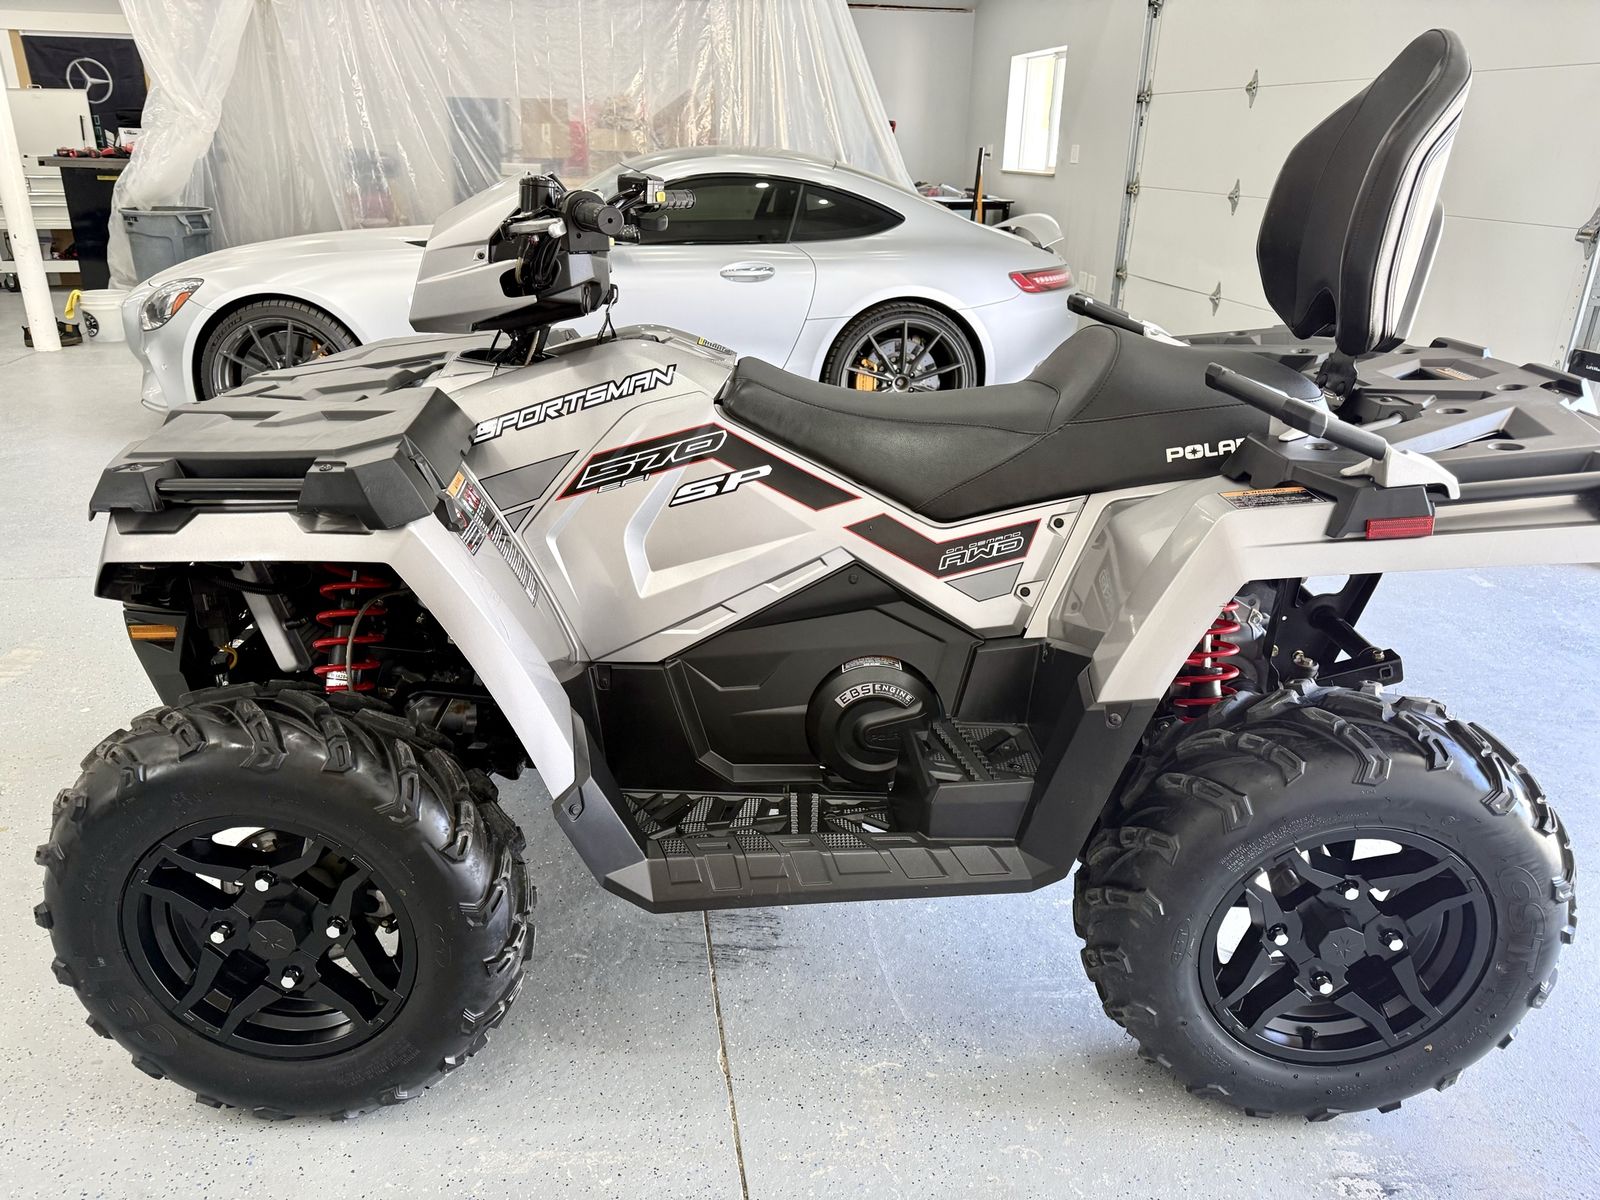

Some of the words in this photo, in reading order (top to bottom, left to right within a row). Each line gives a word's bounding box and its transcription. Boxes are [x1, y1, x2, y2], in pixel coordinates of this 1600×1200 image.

[472, 364, 677, 445] SPORTSMAN
[576, 429, 728, 490] 570
[597, 474, 650, 494] EFI
[668, 464, 773, 508] SP
[938, 536, 1024, 570] AWD
[946, 545, 964, 555] ON
[968, 531, 1022, 549] DEMAND
[840, 685, 872, 705] EBS
[874, 684, 913, 702] ENGINE
